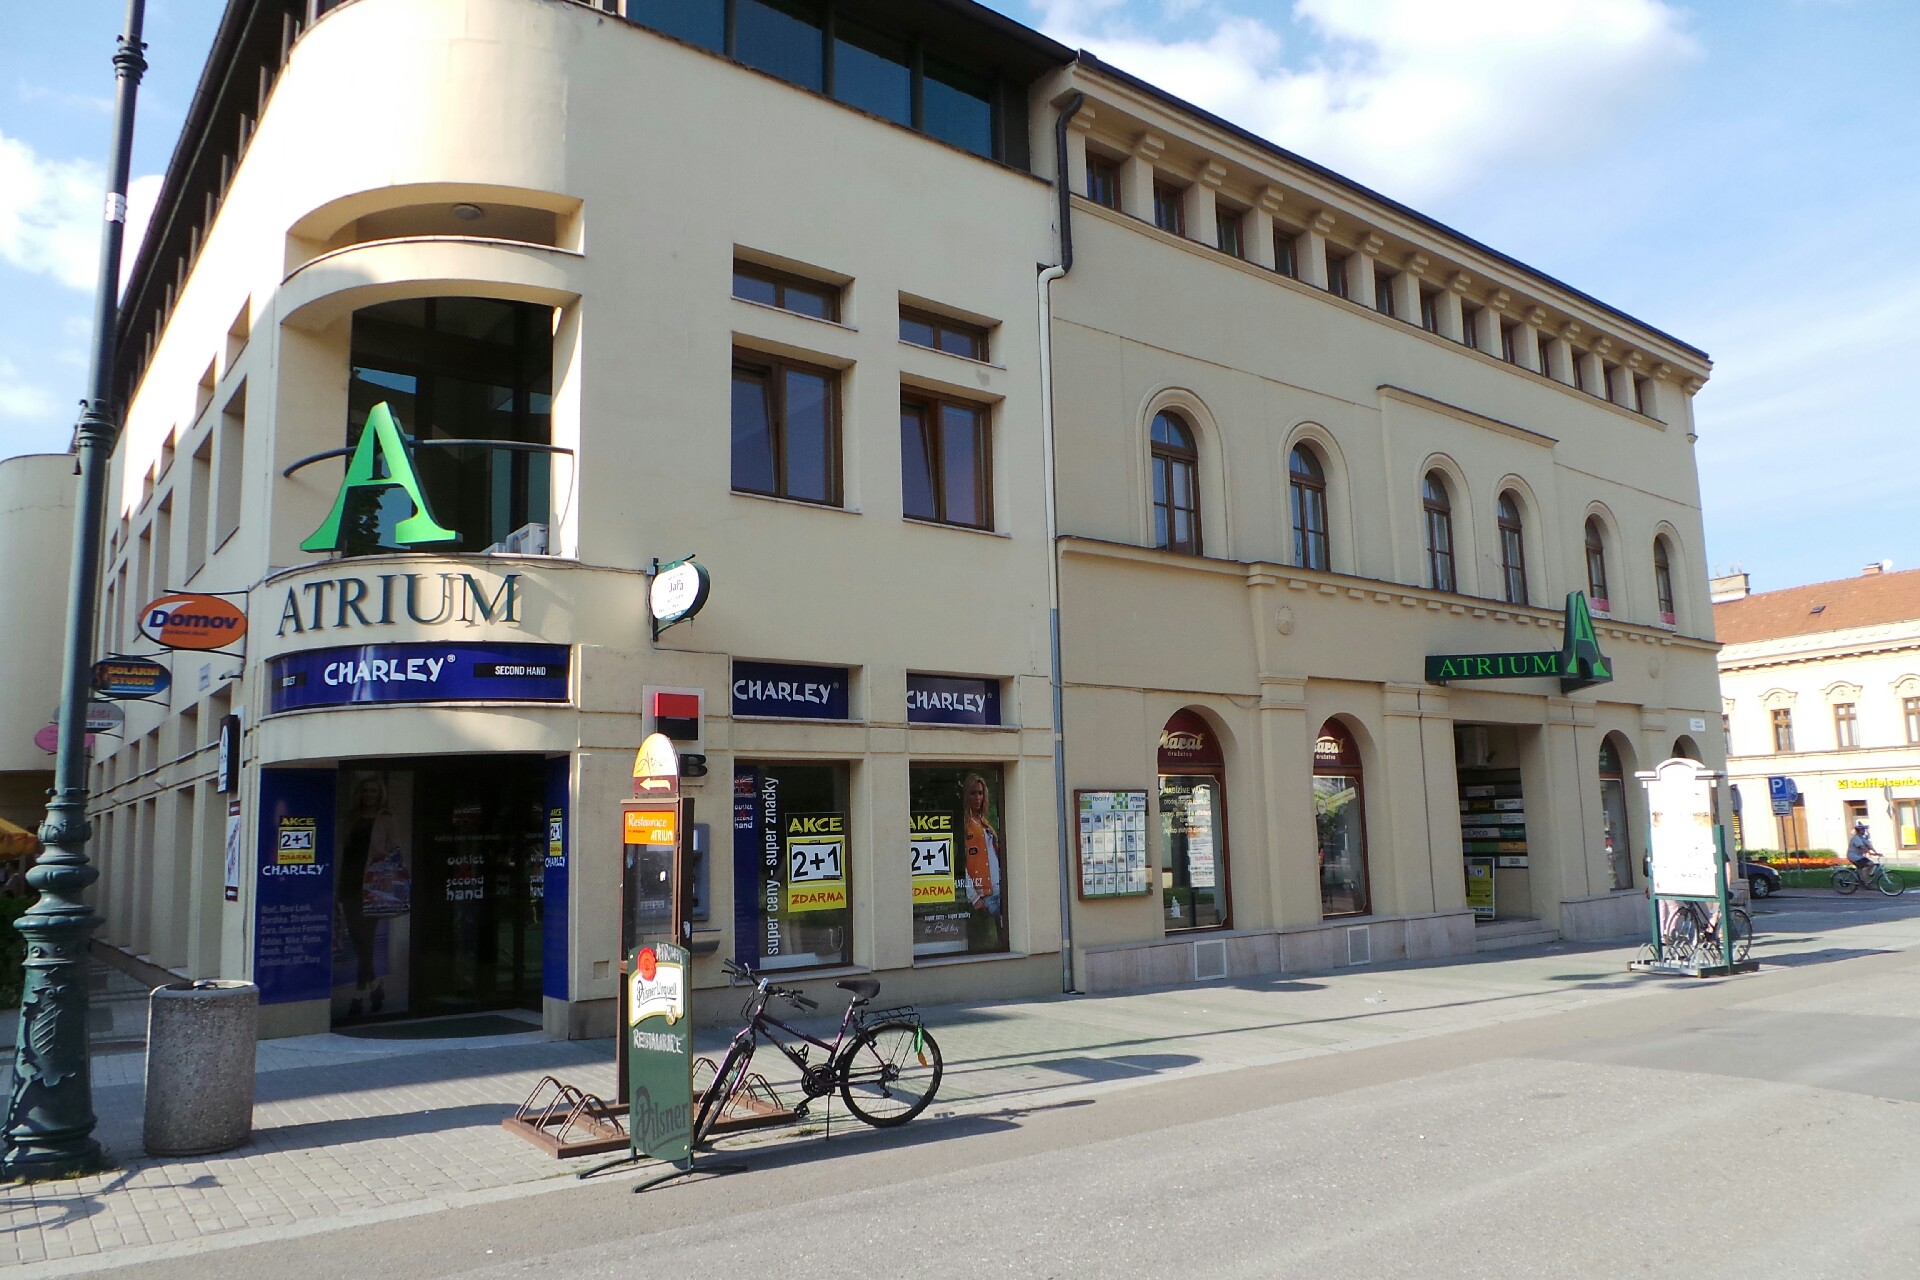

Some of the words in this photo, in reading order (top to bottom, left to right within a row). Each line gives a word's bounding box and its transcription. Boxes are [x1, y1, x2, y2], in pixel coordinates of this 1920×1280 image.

[275, 572, 523, 638] ATRIUM
[148, 609, 239, 630] Domov
[494, 665, 525, 677] SECOND
[526, 665, 547, 677] HAND
[1439, 654, 1559, 677] ATRIUM
[1771, 779, 1783, 794] P
[761, 776, 780, 824] značky
[281, 817, 315, 826] AKCE
[627, 813, 668, 827] Restaurace
[789, 816, 843, 834] AKCE
[281, 832, 312, 848] 2+1
[650, 829, 673, 842] ATRIUM
[764, 827, 780, 867] super
[447, 854, 485, 866] outlet
[792, 845, 841, 879] 2+1
[911, 842, 950, 872] 2+1
[446, 876, 484, 888] second
[446, 886, 484, 901] hand
[766, 879, 781, 911] ceny
[791, 891, 844, 906] ZDARMA
[767, 917, 782, 956] super
[636, 979, 658, 1008] Pilsner
[634, 1085, 690, 1151] Pilsner
